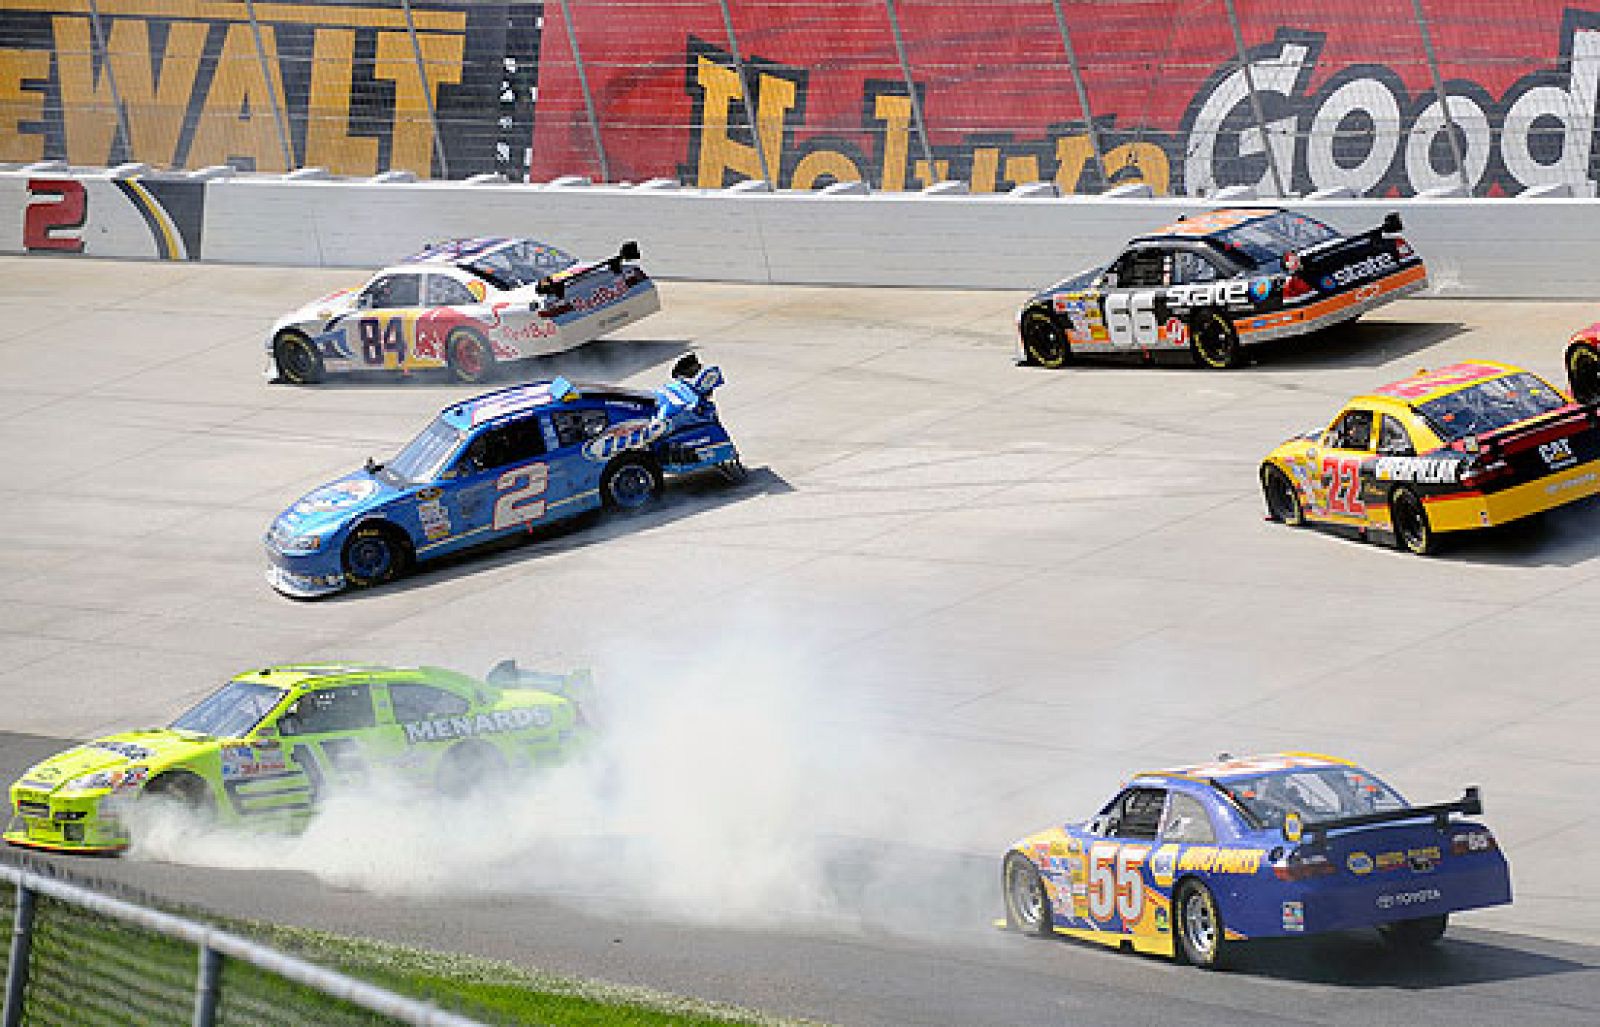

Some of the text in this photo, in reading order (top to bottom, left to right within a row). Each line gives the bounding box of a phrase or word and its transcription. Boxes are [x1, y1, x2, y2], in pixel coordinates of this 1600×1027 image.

[23, 179, 88, 252] 2
[360, 316, 407, 366] 84
[1106, 293, 1157, 346] 66
[493, 462, 549, 531] 2
[1322, 456, 1365, 514] 22
[404, 708, 552, 744] MENARDS
[1088, 842, 1149, 924] 55
